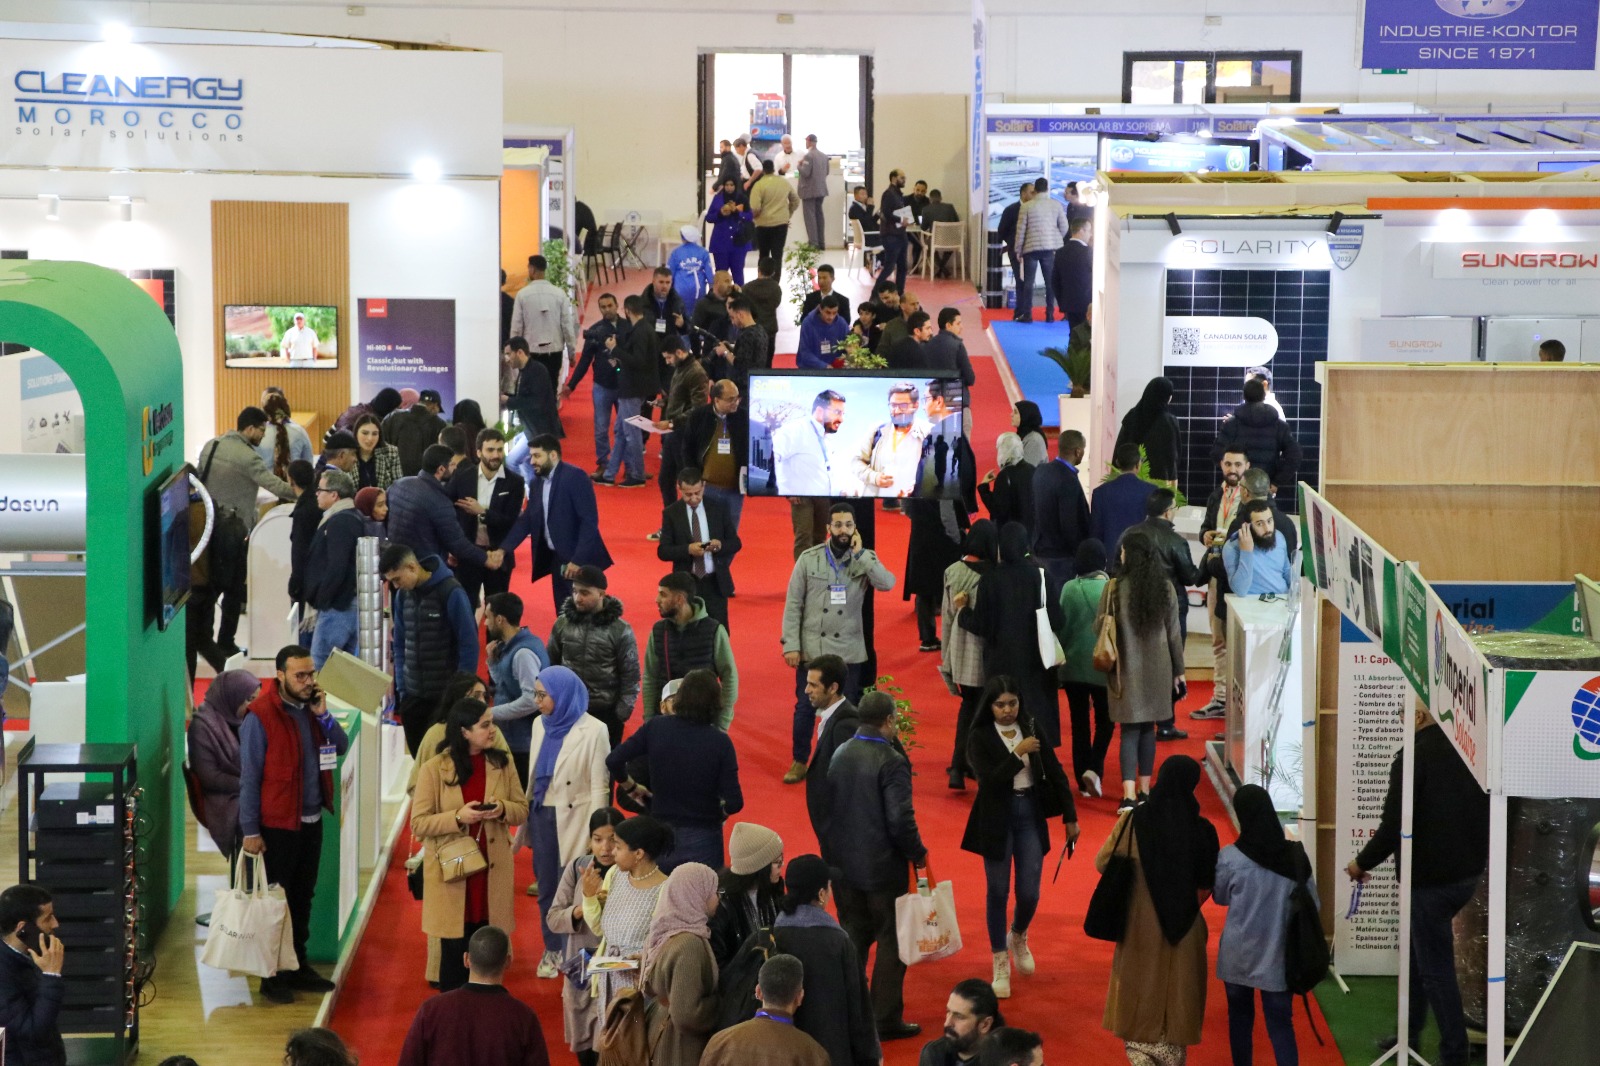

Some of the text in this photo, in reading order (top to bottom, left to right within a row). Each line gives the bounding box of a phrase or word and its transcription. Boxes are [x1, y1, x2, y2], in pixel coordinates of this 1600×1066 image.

[1379, 25, 1578, 38] INDUSTRIE-KONTOR
[1418, 47, 1536, 59] SINCE 1971
[14, 70, 243, 101] CLEANERGY
[18, 106, 242, 129] MOROCCO
[995, 119, 1034, 132] Solaire
[1049, 121, 1171, 131] SOPRASOLAR BY SOPREMA
[15, 126, 243, 142] solar solutions
[1182, 239, 1317, 255] SOLARITY
[1462, 253, 1598, 268] SUNGROW
[1482, 278, 1509, 286] Clean
[1513, 279, 1541, 287] power
[1547, 278, 1560, 286] for
[1389, 340, 1443, 348] SUNGROW
[367, 364, 449, 374] Revolutionary Changes
[1446, 598, 1495, 619] rial
[1358, 726, 1374, 734] Type
[1357, 751, 1391, 759] Matériaux
[1357, 786, 1389, 795] Epaisseu
[1356, 812, 1382, 820] Epaiss
[1378, 917, 1400, 925] Suppo
[1355, 934, 1389, 942] Epaisseur
